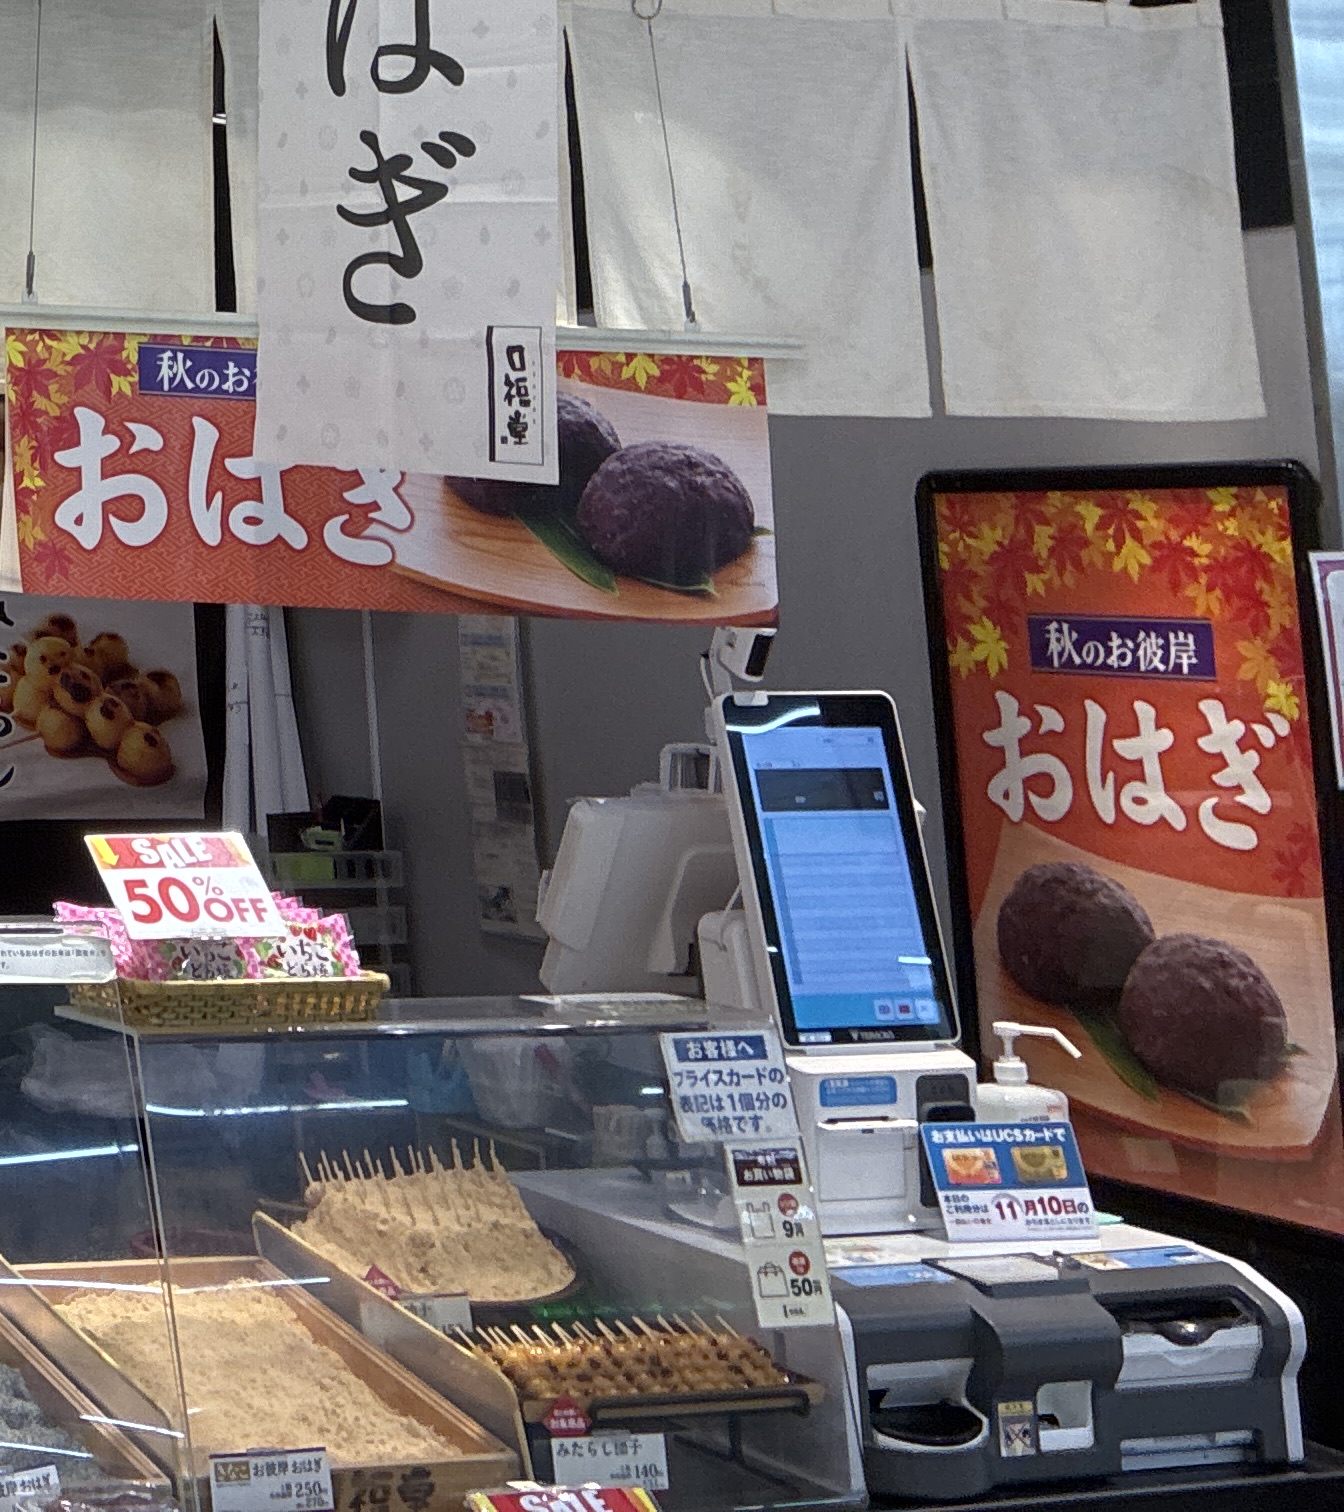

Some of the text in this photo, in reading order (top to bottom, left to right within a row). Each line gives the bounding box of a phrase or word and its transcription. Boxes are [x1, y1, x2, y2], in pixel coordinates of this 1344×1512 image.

[154, 349, 257, 396] 秋のお
[1044, 619, 1200, 675] 秋のお彼岸
[982, 690, 1291, 850] おはぎ
[132, 837, 212, 869] SALE
[686, 1039, 755, 1060] お客様へ
